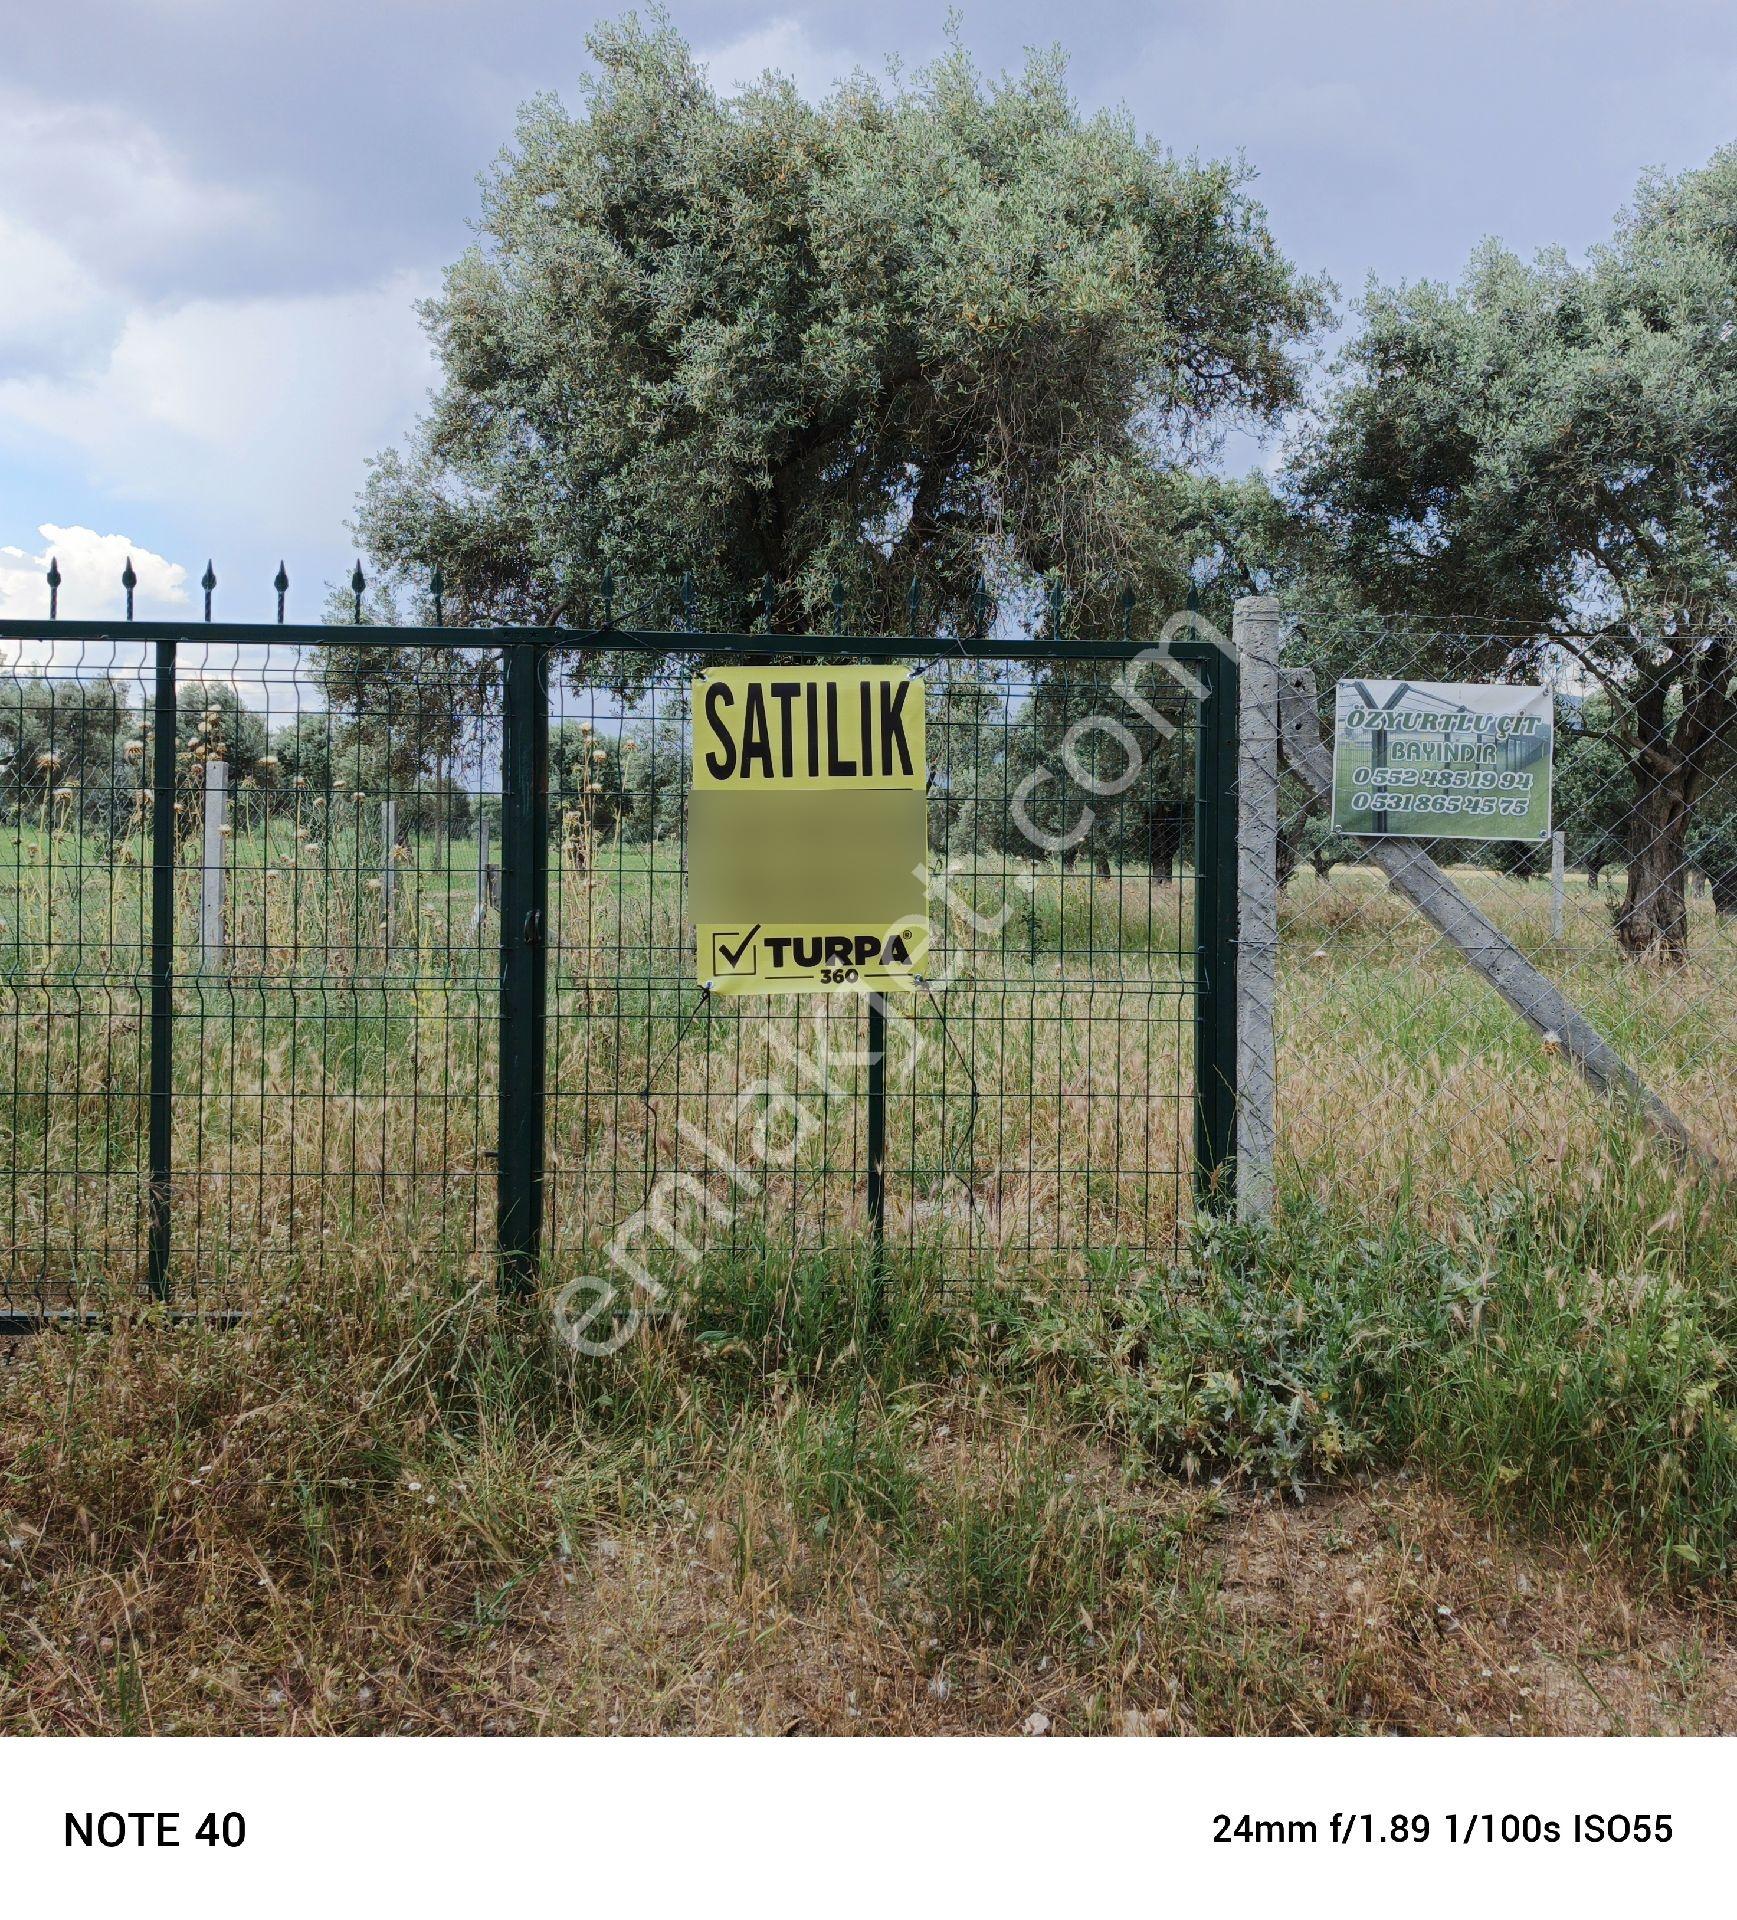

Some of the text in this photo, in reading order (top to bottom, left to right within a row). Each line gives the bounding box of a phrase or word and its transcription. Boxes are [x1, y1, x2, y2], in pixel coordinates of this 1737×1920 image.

[705, 681, 914, 781] SATILIK
[1346, 704, 1544, 740] ÖZYURTLU ÇİT
[1391, 741, 1497, 764] BAYINDIR
[1421, 769, 1469, 788] 485
[1499, 772, 1533, 790] 94
[1464, 796, 1496, 815] 45
[1499, 798, 1530, 815] 75
[820, 968, 859, 984] 360
